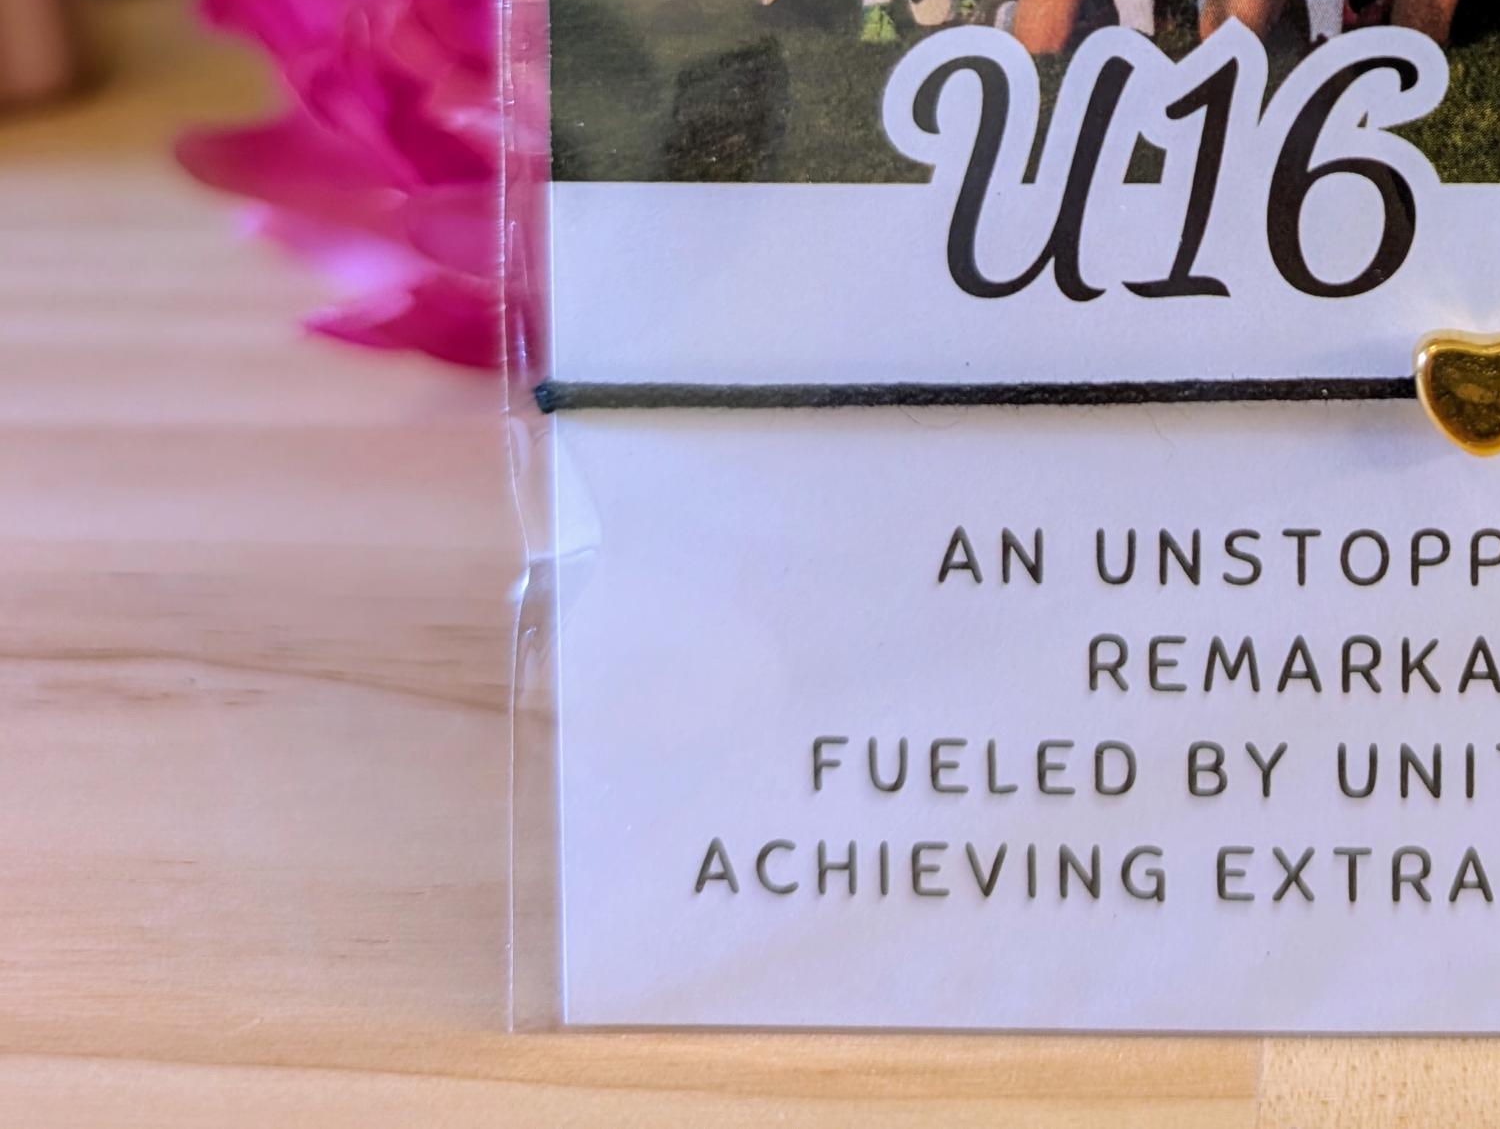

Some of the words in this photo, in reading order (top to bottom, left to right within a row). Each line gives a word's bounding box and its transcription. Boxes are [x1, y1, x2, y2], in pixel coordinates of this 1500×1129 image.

[912, 55, 1419, 302] U16
[937, 526, 1043, 585] AN
[812, 736, 1137, 797] FUELED
[1187, 741, 1287, 799] BY
[694, 838, 1165, 904] ACHIEVING
